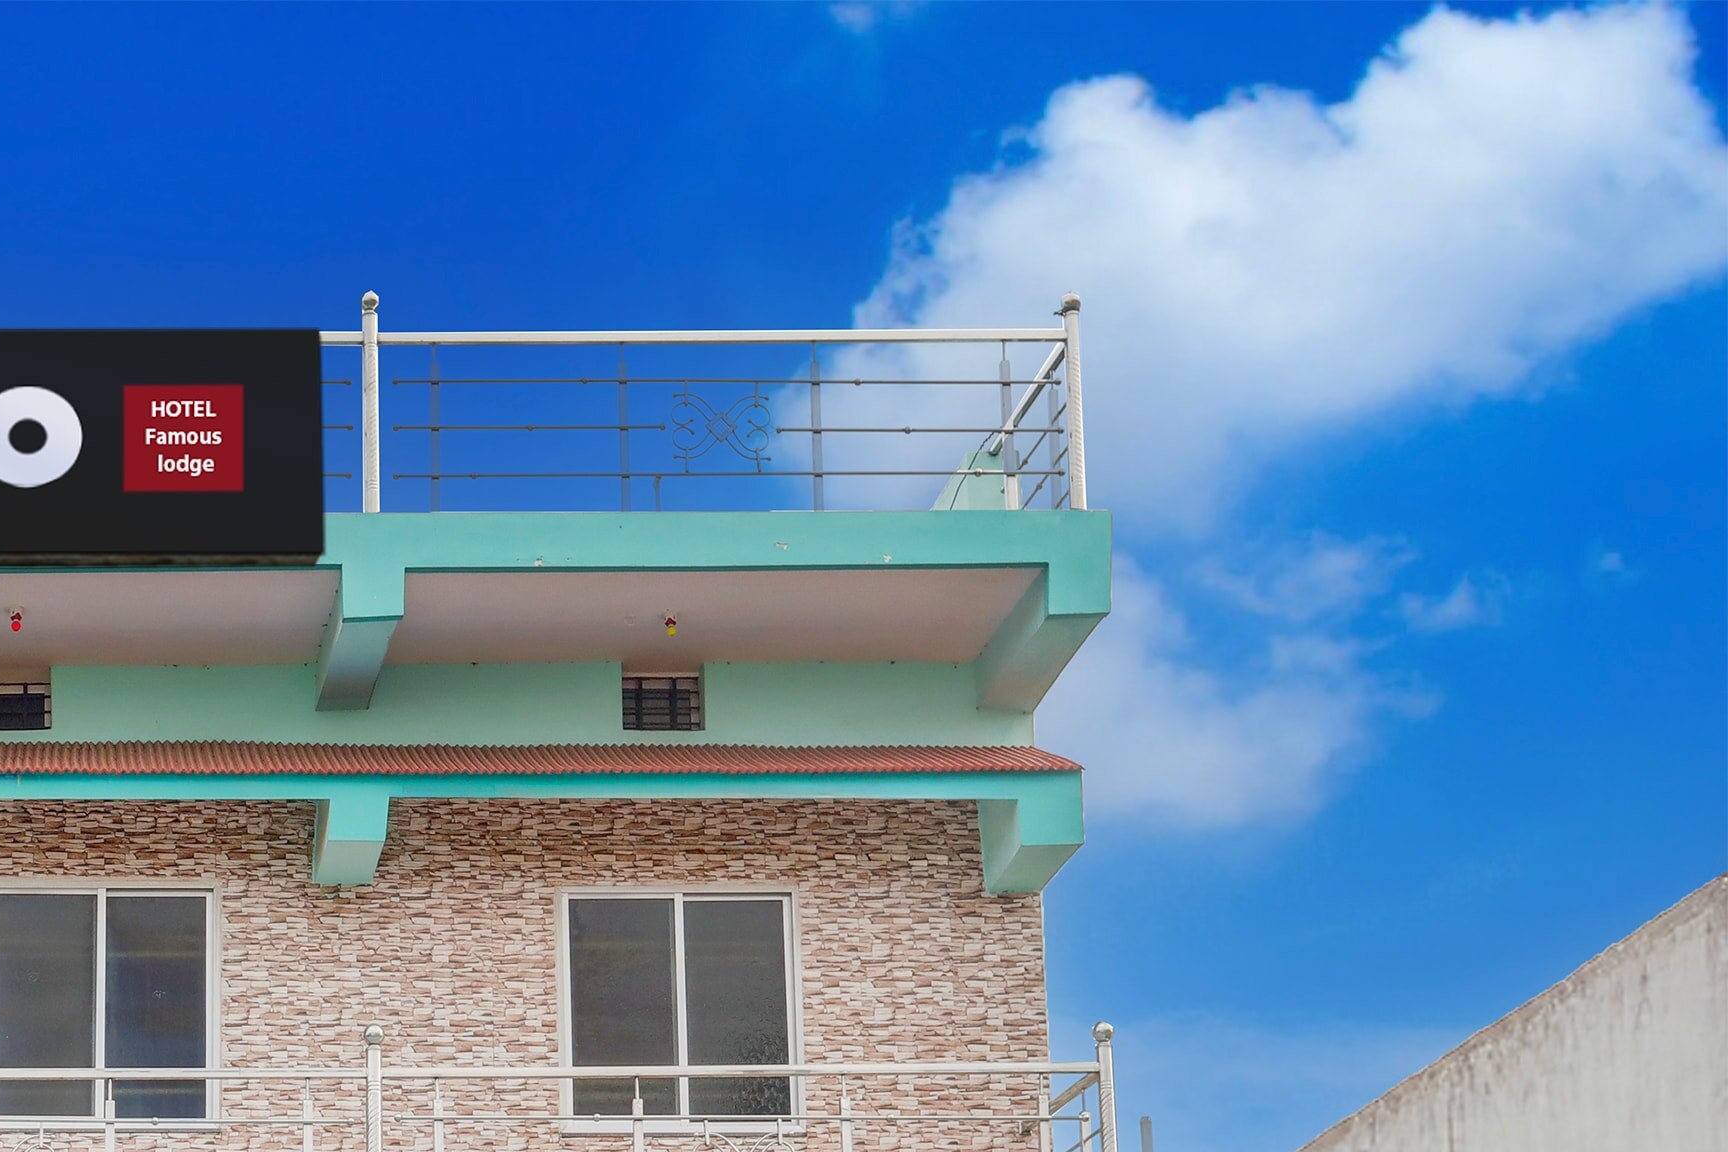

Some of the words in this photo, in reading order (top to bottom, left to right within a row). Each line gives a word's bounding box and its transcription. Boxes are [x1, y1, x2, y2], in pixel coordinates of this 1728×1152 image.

[151, 400, 217, 418] HOTEL
[145, 427, 223, 446] Famous
[158, 453, 215, 476] lodge
